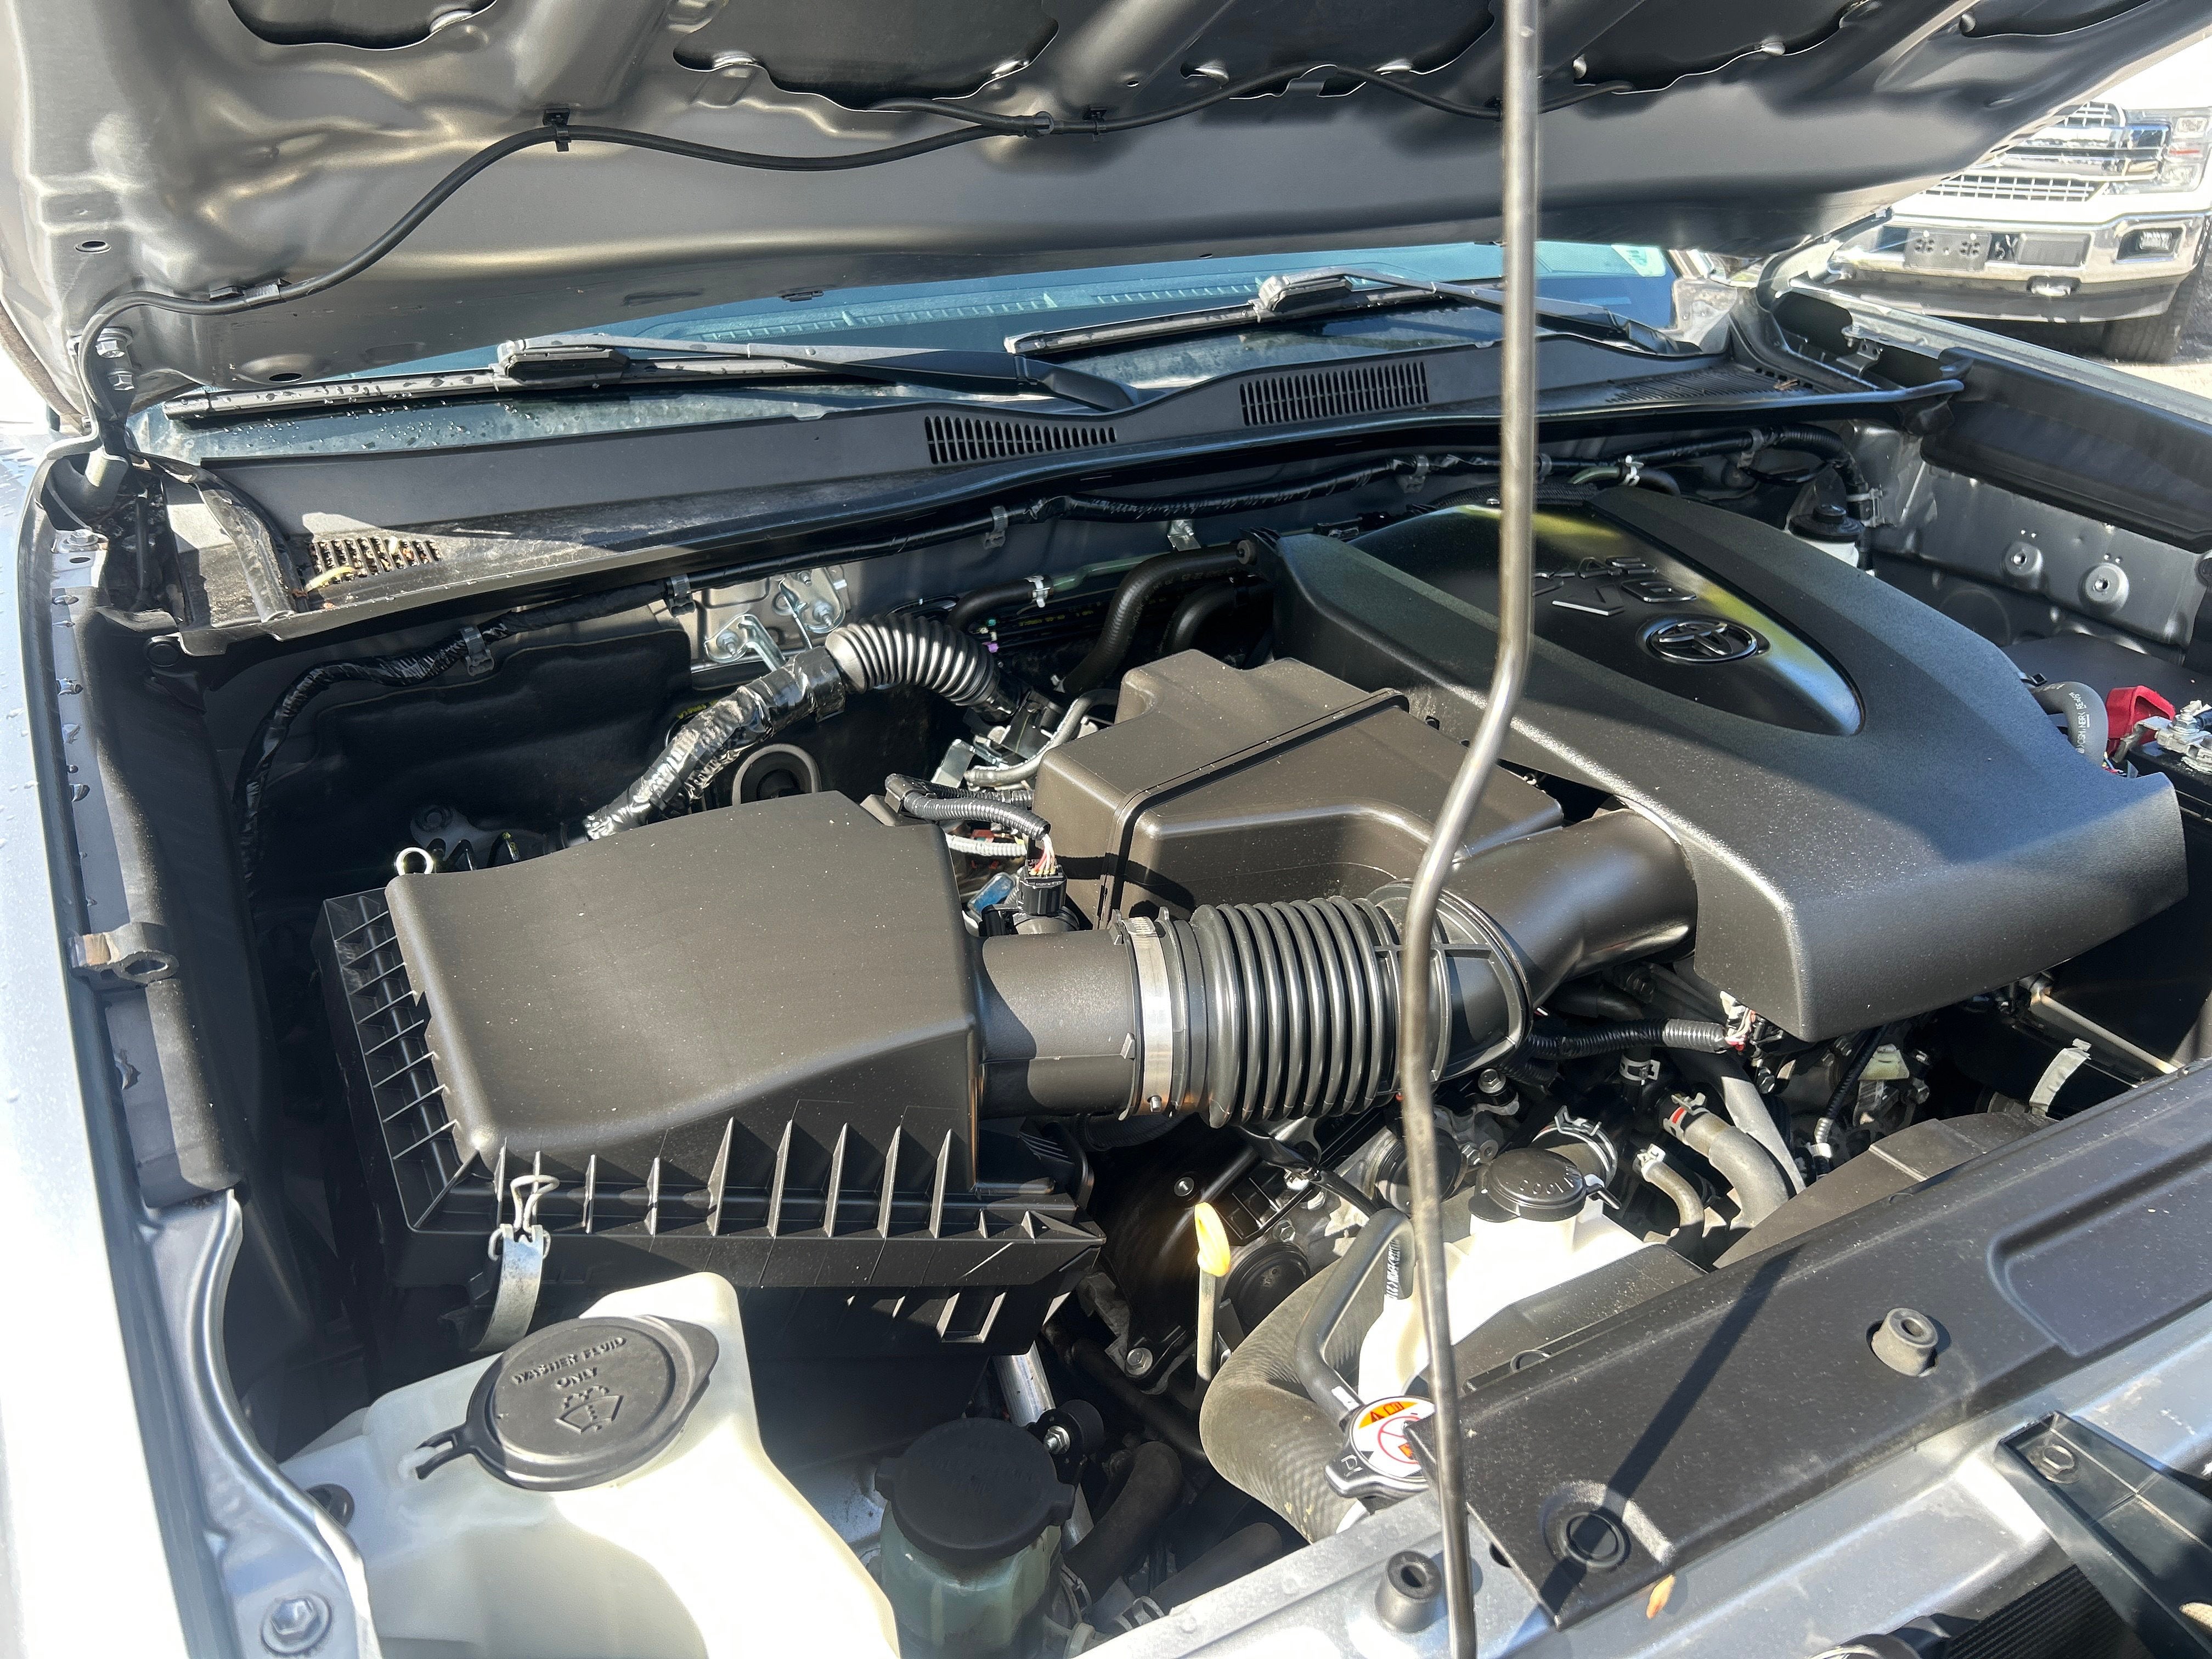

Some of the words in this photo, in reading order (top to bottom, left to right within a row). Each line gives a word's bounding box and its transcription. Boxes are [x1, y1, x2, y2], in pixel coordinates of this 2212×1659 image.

[1551, 579, 1697, 616] V6
[511, 1353, 579, 1385] WASHER
[580, 1336, 627, 1362] FLUID
[555, 1367, 598, 1390] ONLY
